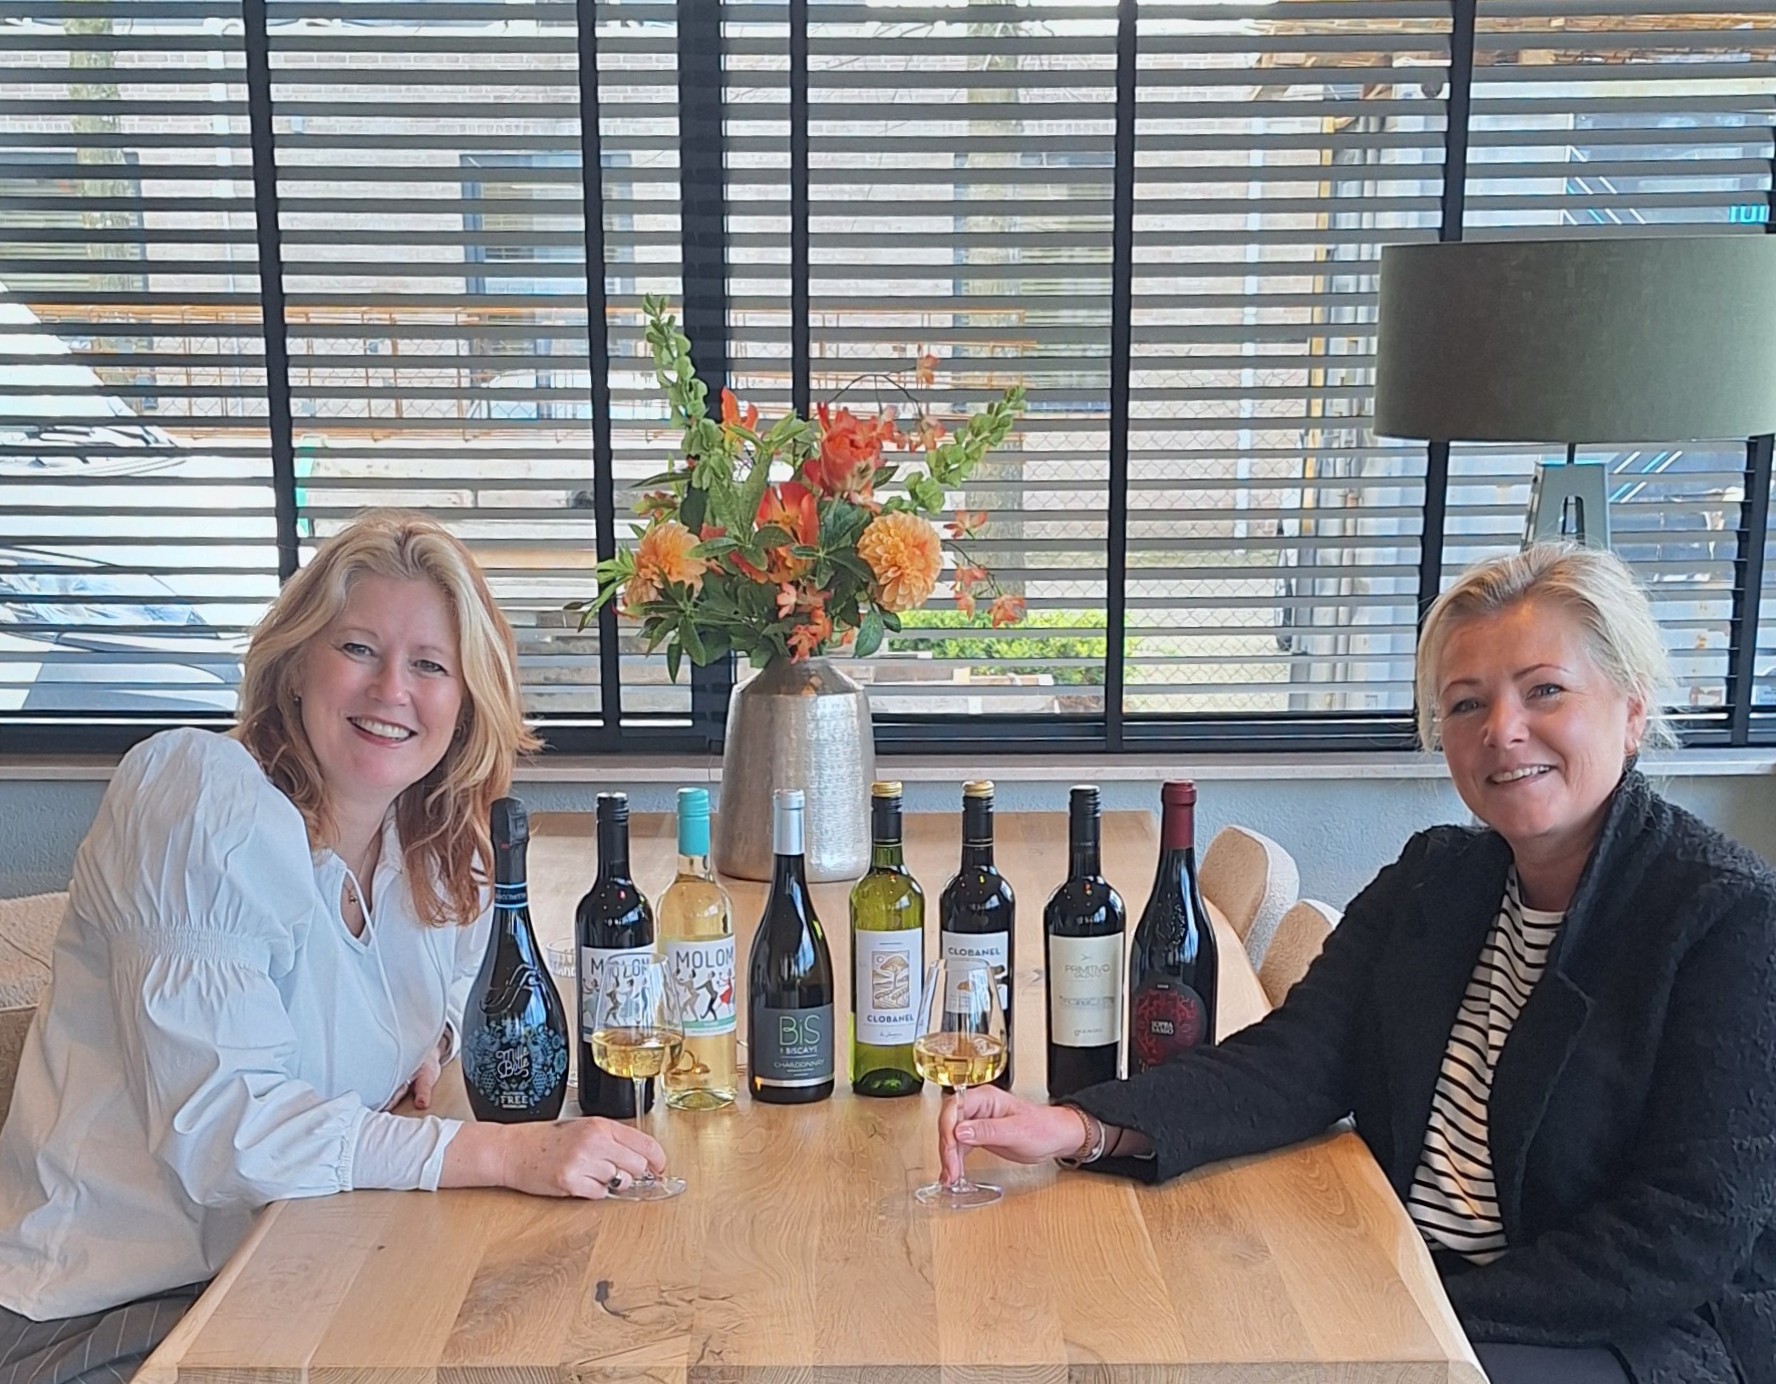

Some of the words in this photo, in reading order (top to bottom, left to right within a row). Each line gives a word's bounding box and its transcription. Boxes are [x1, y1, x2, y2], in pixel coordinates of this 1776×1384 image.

[948, 947, 1001, 956] CLOBANEL
[1065, 963, 1110, 974] PRIMITIVO
[867, 1014, 914, 1023] CLOBANEL
[773, 1058, 825, 1069] CHARDONNAY
[501, 1095, 528, 1104] FREE
